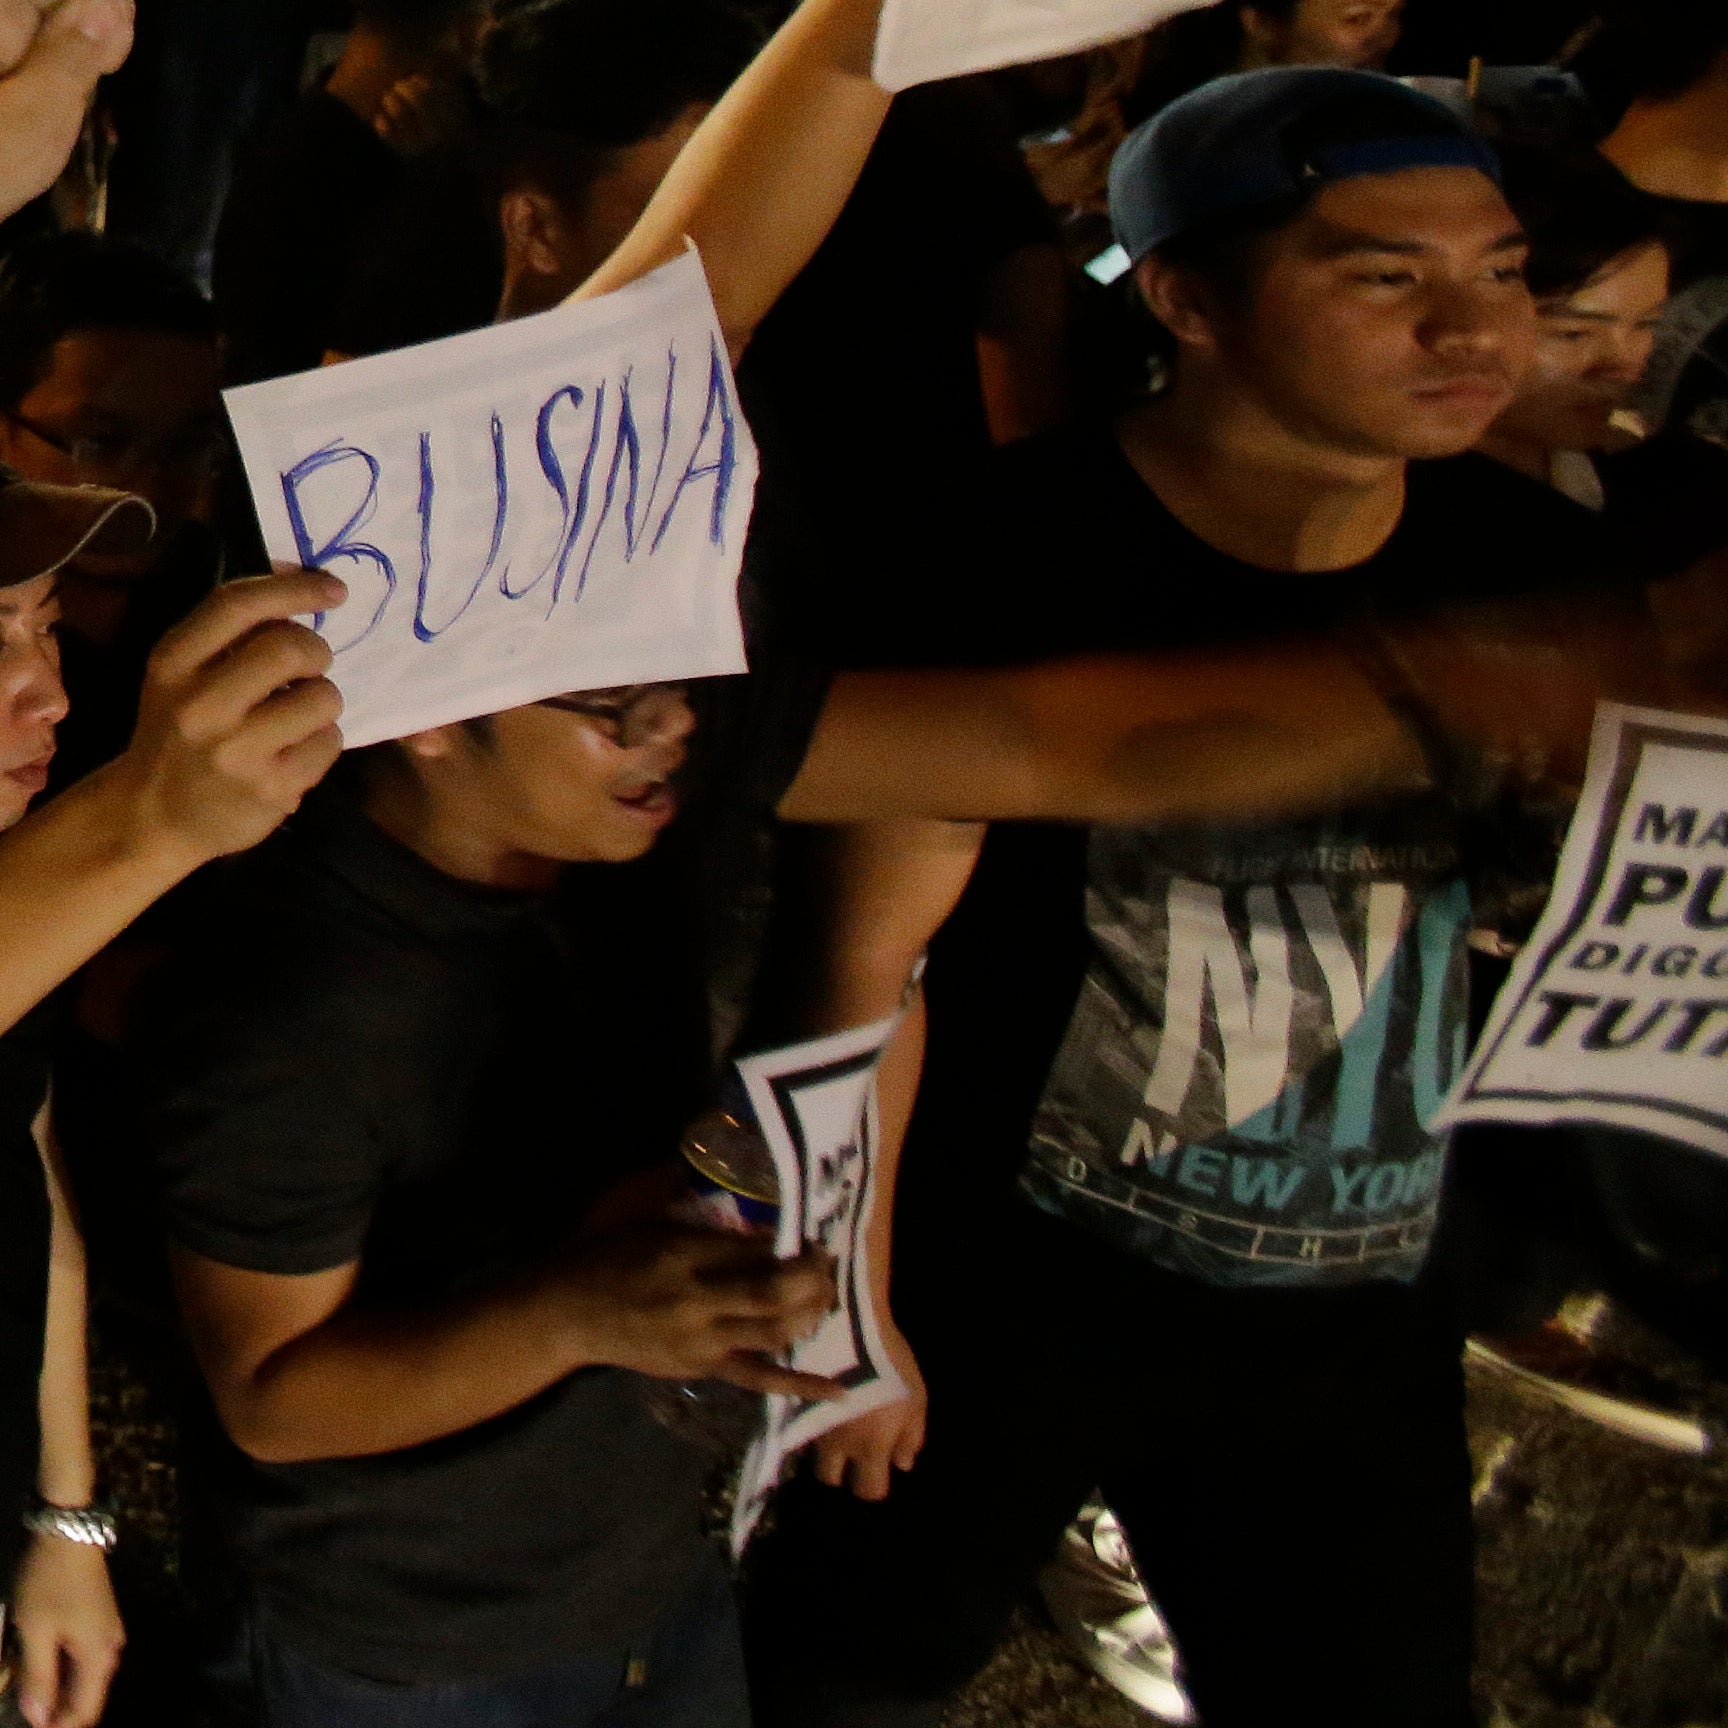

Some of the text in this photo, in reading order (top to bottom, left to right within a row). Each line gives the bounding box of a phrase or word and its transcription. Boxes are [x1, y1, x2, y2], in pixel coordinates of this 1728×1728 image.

[279, 329, 738, 654] BUSINA
[1523, 989, 1728, 1058] TUT
[1119, 1117, 1307, 1210] NEW
